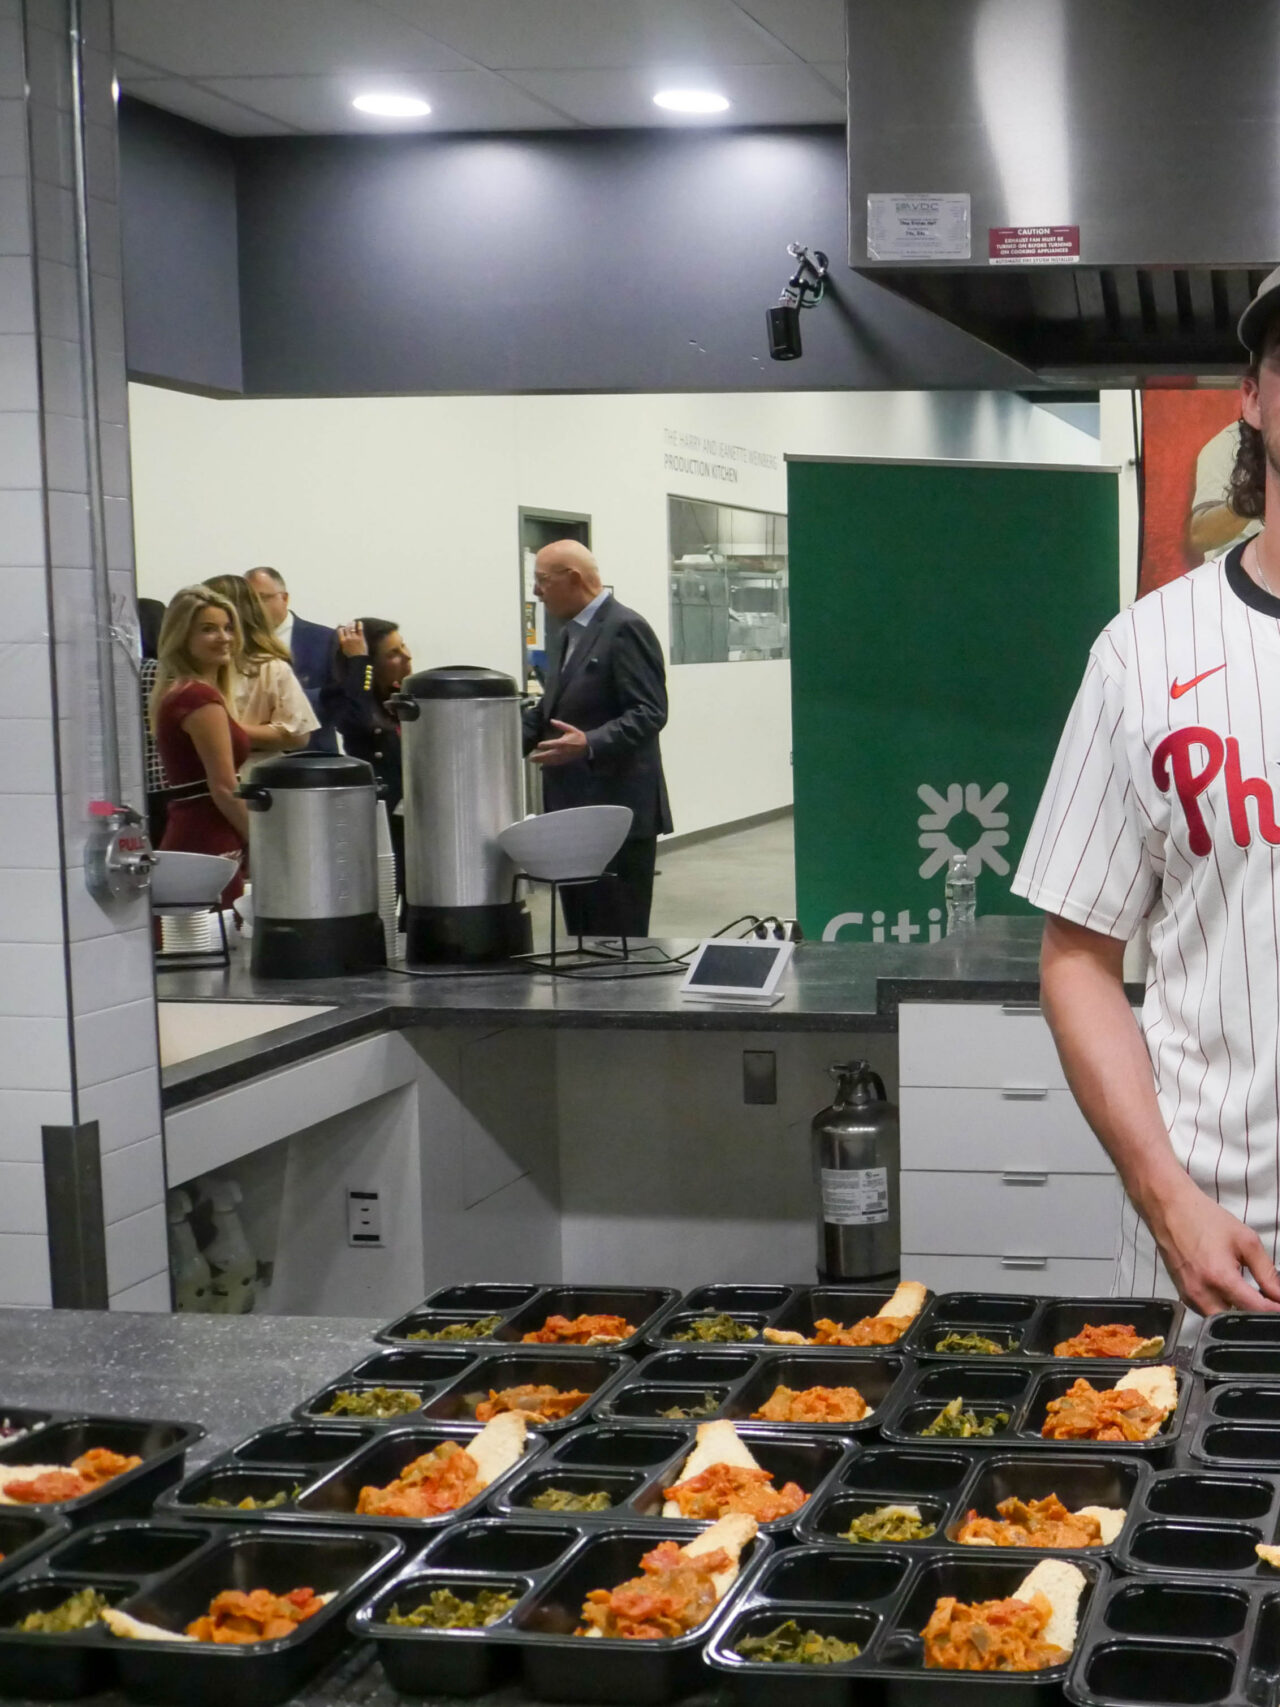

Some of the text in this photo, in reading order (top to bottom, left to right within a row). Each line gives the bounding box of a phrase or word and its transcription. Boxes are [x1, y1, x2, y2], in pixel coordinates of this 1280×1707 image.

[1017, 227, 1051, 236] CAUTION
[1004, 236, 1029, 244] EXHAUST
[702, 438, 718, 457] AND
[664, 452, 738, 483] PRODUCTION KITCHEN
